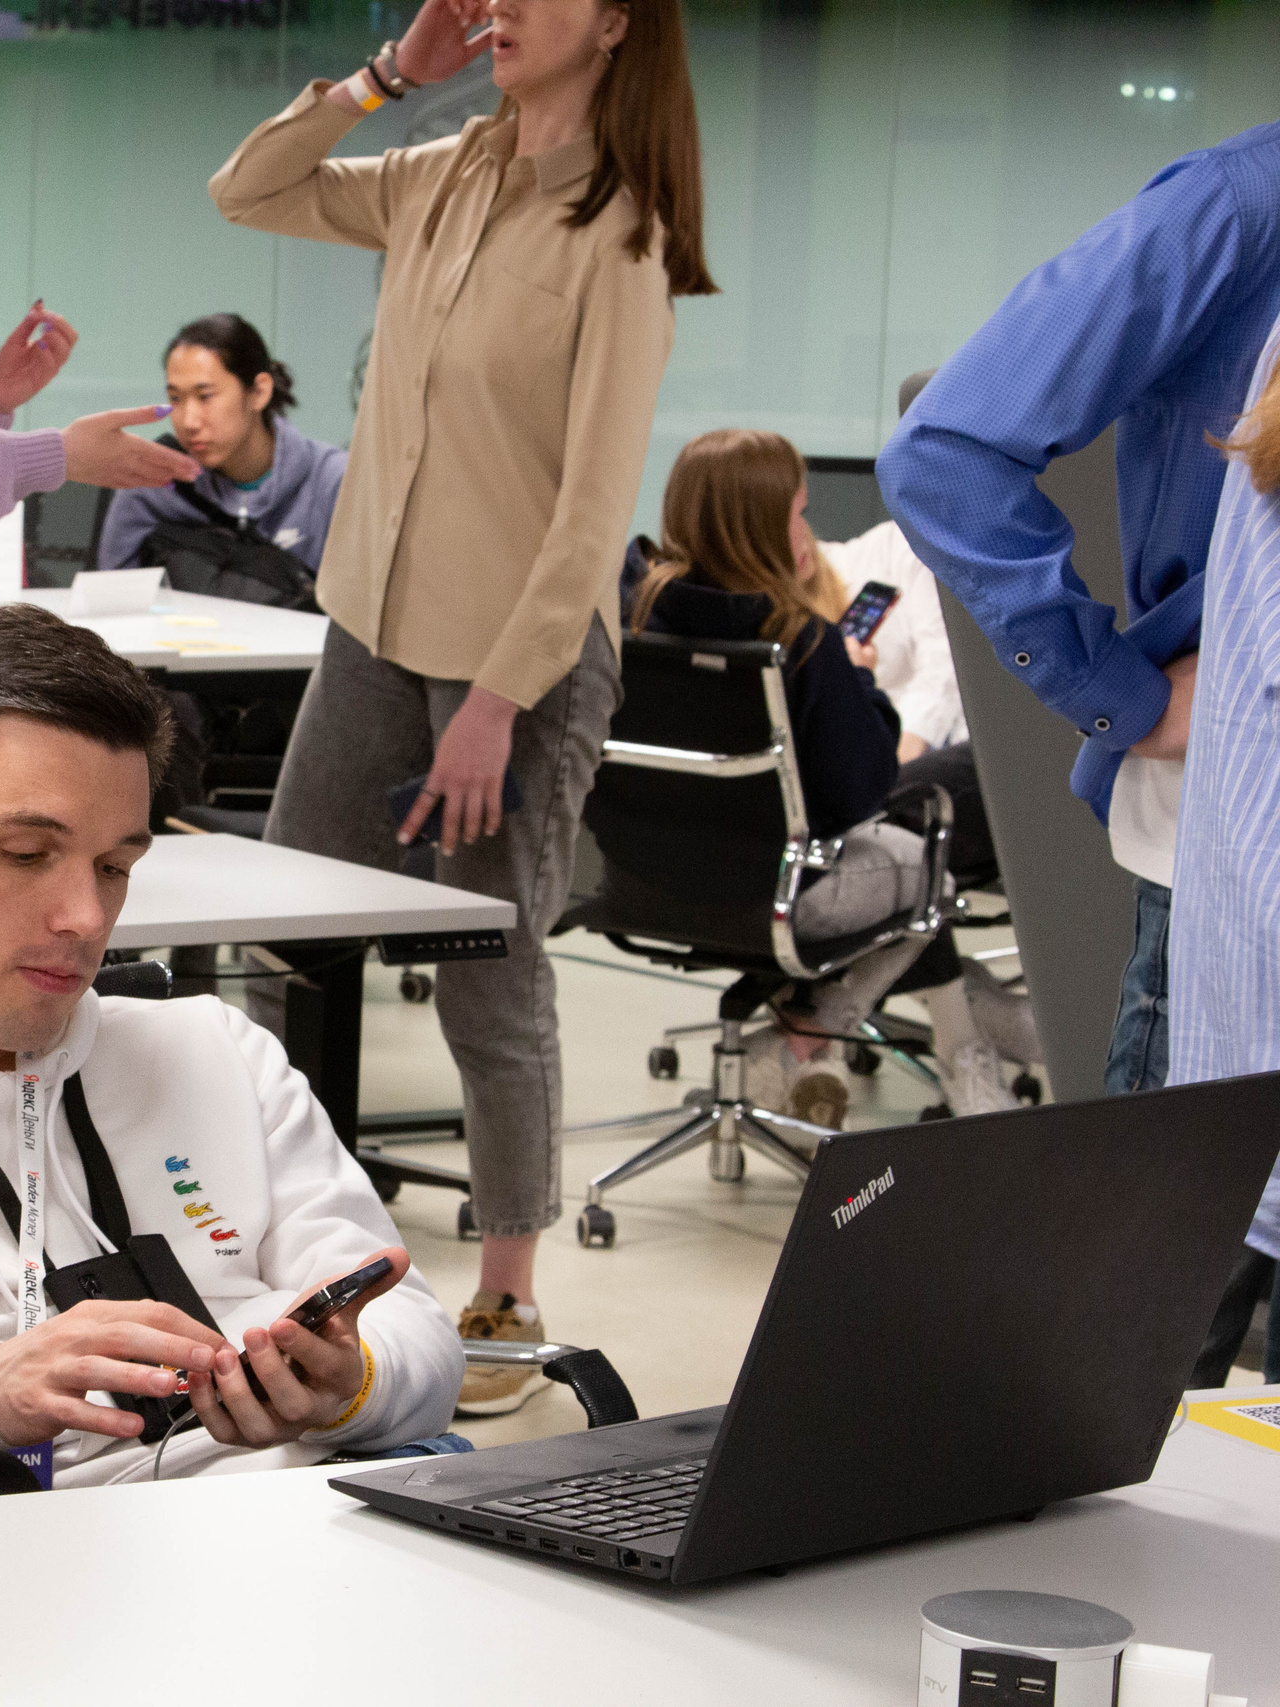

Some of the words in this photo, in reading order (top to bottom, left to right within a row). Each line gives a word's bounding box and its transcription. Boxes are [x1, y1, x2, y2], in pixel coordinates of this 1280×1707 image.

[22, 1074, 39, 1111] Яндекс
[22, 1112, 39, 1150] Деньги
[27, 1170, 40, 1206] Yandex
[830, 1165, 895, 1230] ThinkPad
[25, 1207, 39, 1240] Money
[23, 1258, 39, 1301] Яндекс
[17, 1453, 42, 1467] AN
[924, 1676, 948, 1694] GTV
